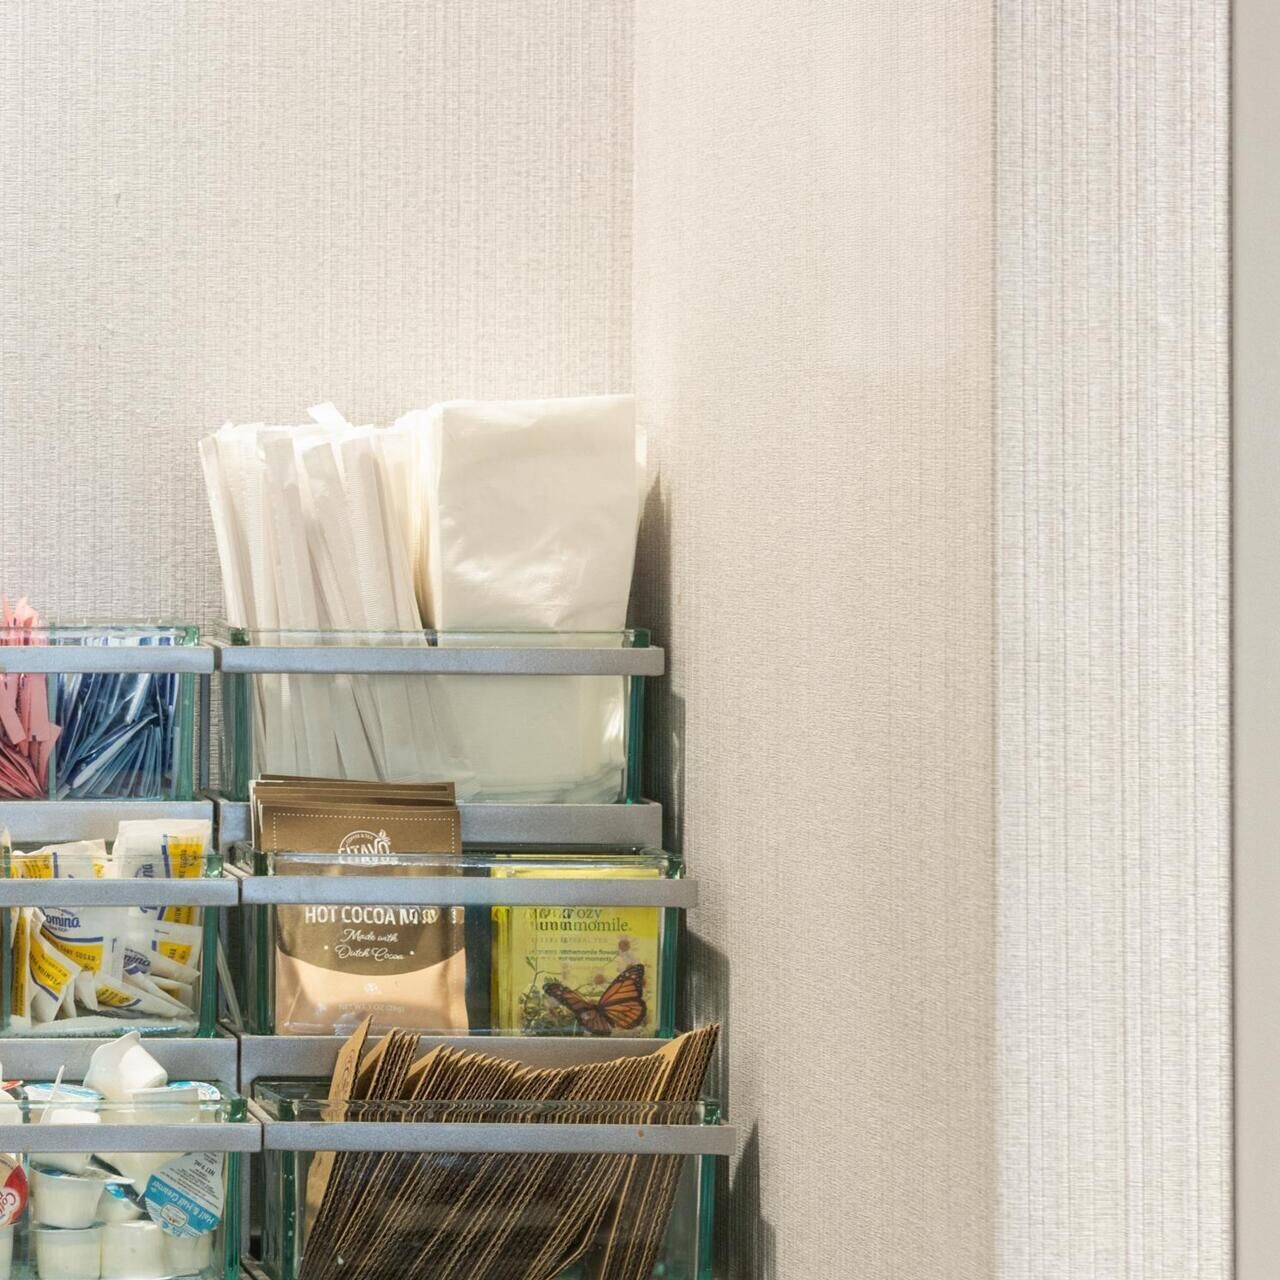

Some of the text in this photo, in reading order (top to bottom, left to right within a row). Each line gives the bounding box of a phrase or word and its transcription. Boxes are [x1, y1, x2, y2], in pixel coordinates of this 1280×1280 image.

[45, 913, 81, 929] omino
[304, 906, 338, 924] HOT
[341, 905, 396, 925] COCOA
[340, 929, 376, 943] Made
